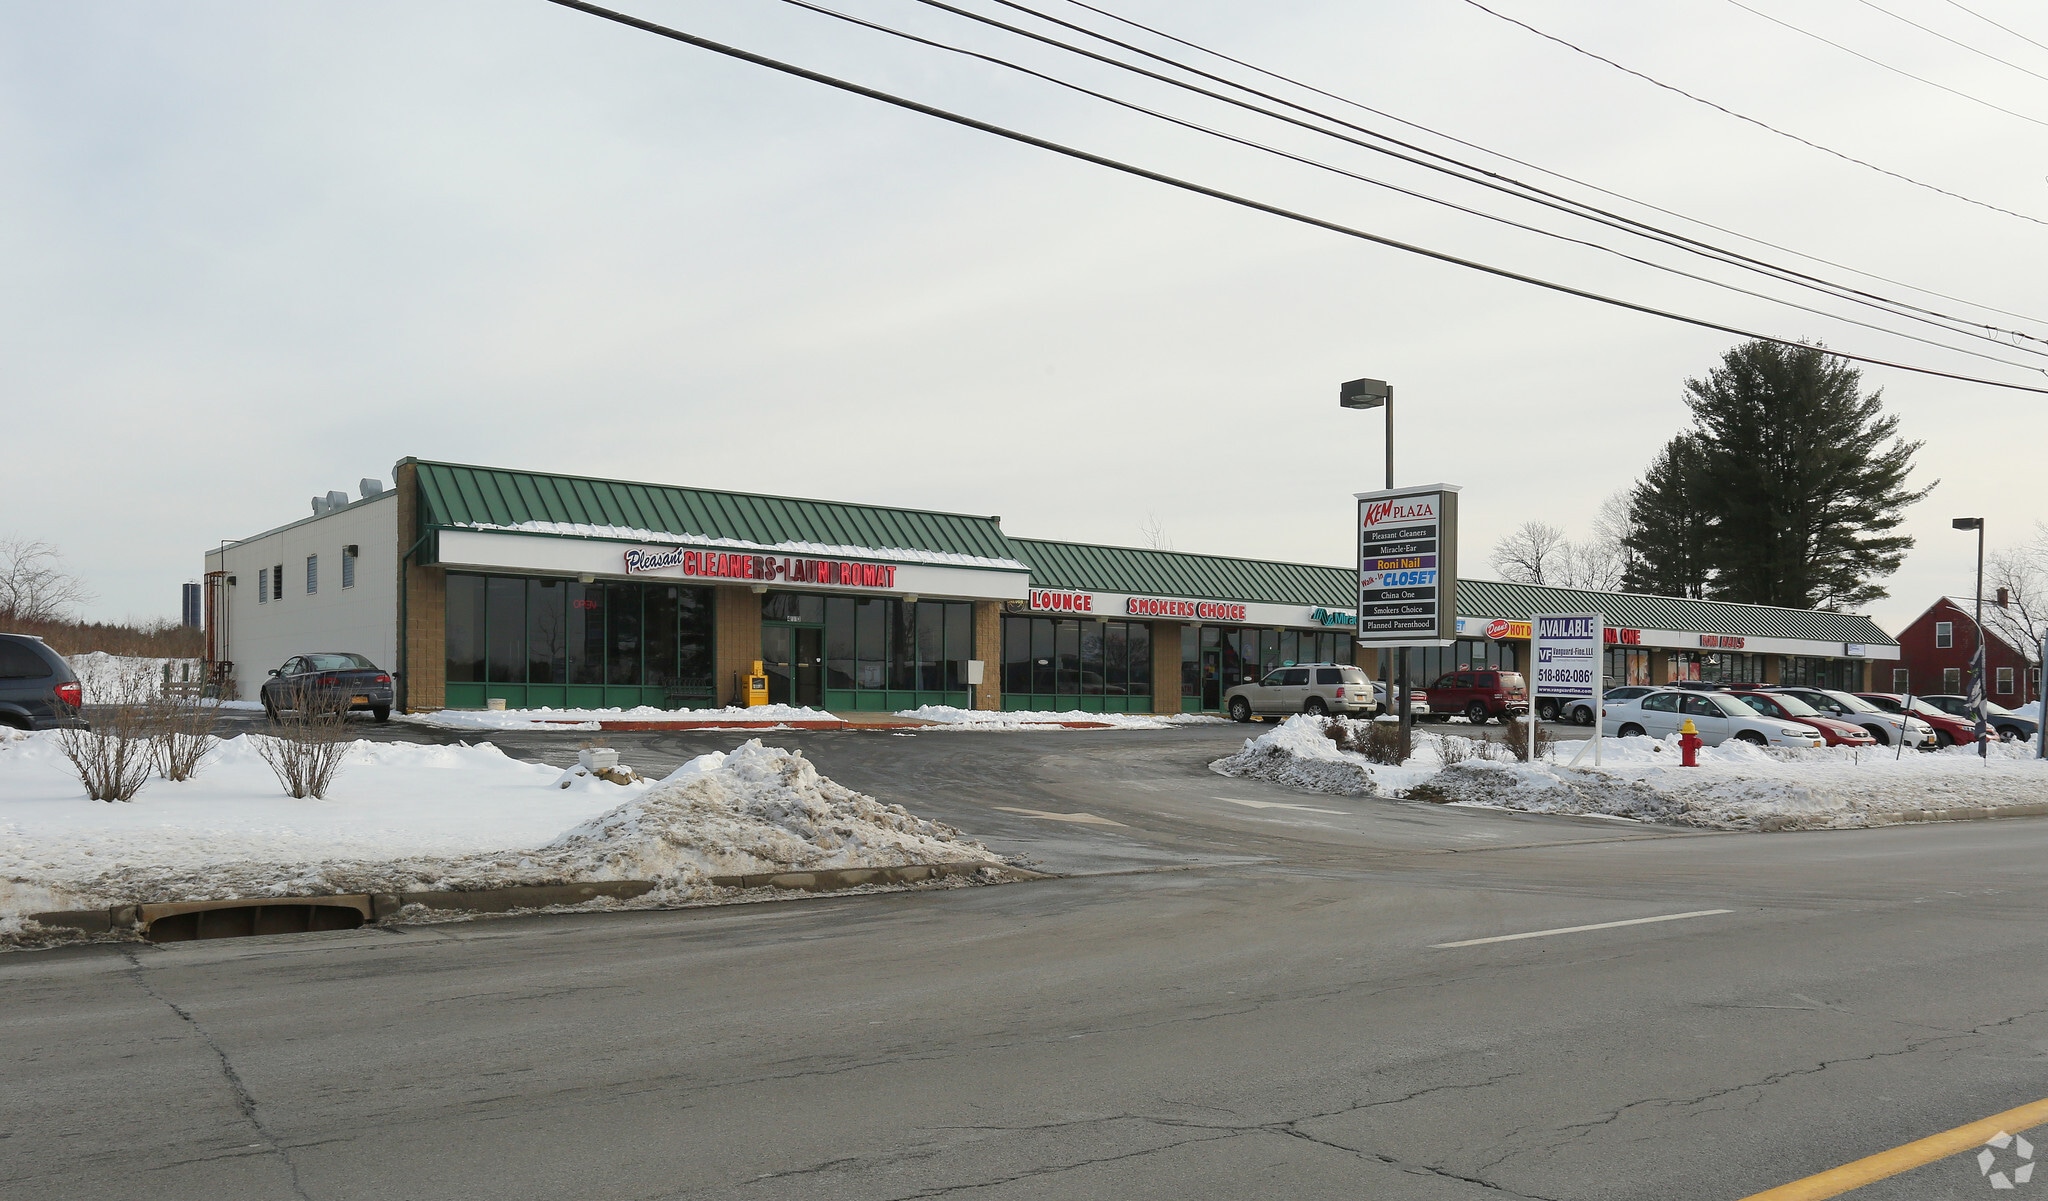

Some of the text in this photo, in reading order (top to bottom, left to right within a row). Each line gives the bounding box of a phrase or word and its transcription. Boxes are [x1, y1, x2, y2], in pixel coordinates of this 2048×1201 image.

[1393, 503, 1433, 518] PLAZA
[1399, 530, 1427, 538] Cleaners
[1380, 544, 1417, 554] Miracle-Ear
[627, 547, 684, 573] Pleasant
[1377, 557, 1420, 570] Roni Nail
[1383, 570, 1436, 587] CLOSET
[1381, 590, 1415, 599] China One
[573, 599, 597, 610] OPEN
[1031, 591, 1092, 612] LOUNGE
[1129, 598, 1246, 620] SMOKERS CHOICE
[1373, 605, 1423, 614] Smokers Choice
[1367, 619, 1430, 629] Planned Parenthood
[1510, 624, 1525, 636] HOT
[1540, 619, 1593, 637] AVAILABLE
[1620, 628, 1641, 645] ONE
[1540, 649, 1552, 661] VF
